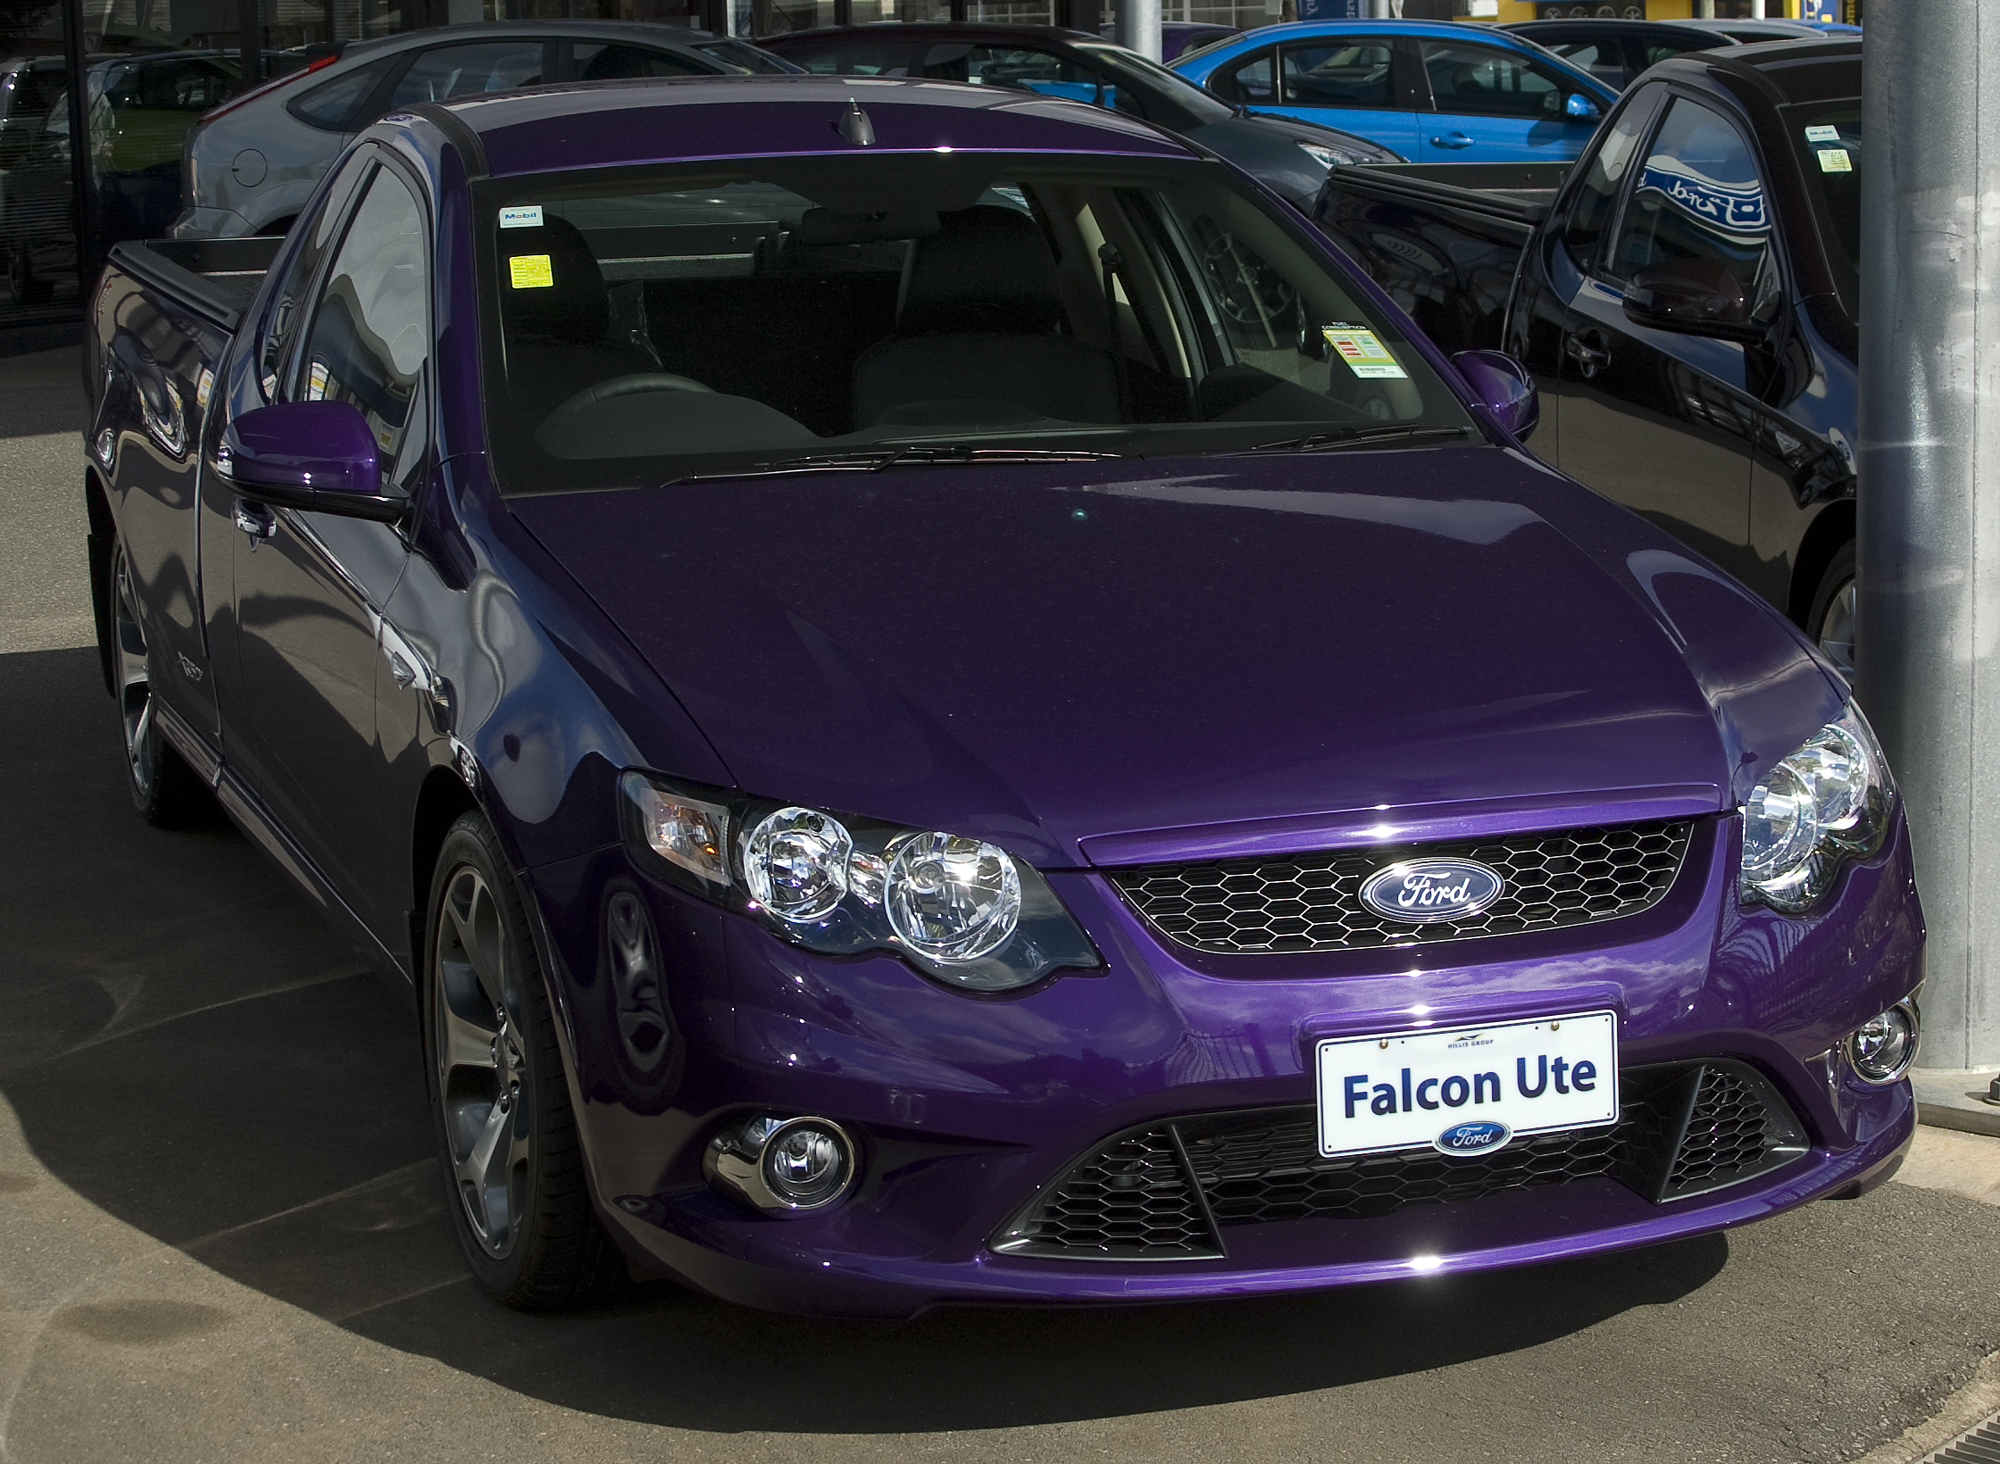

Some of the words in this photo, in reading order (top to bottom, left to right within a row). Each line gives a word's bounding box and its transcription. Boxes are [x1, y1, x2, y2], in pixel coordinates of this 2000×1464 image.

[504, 212, 537, 220] Mobil
[1397, 871, 1471, 907] Ford
[1343, 1067, 1502, 1119] Falcon
[1516, 1054, 1597, 1099] Ute
[1453, 1126, 1493, 1147] Ford
